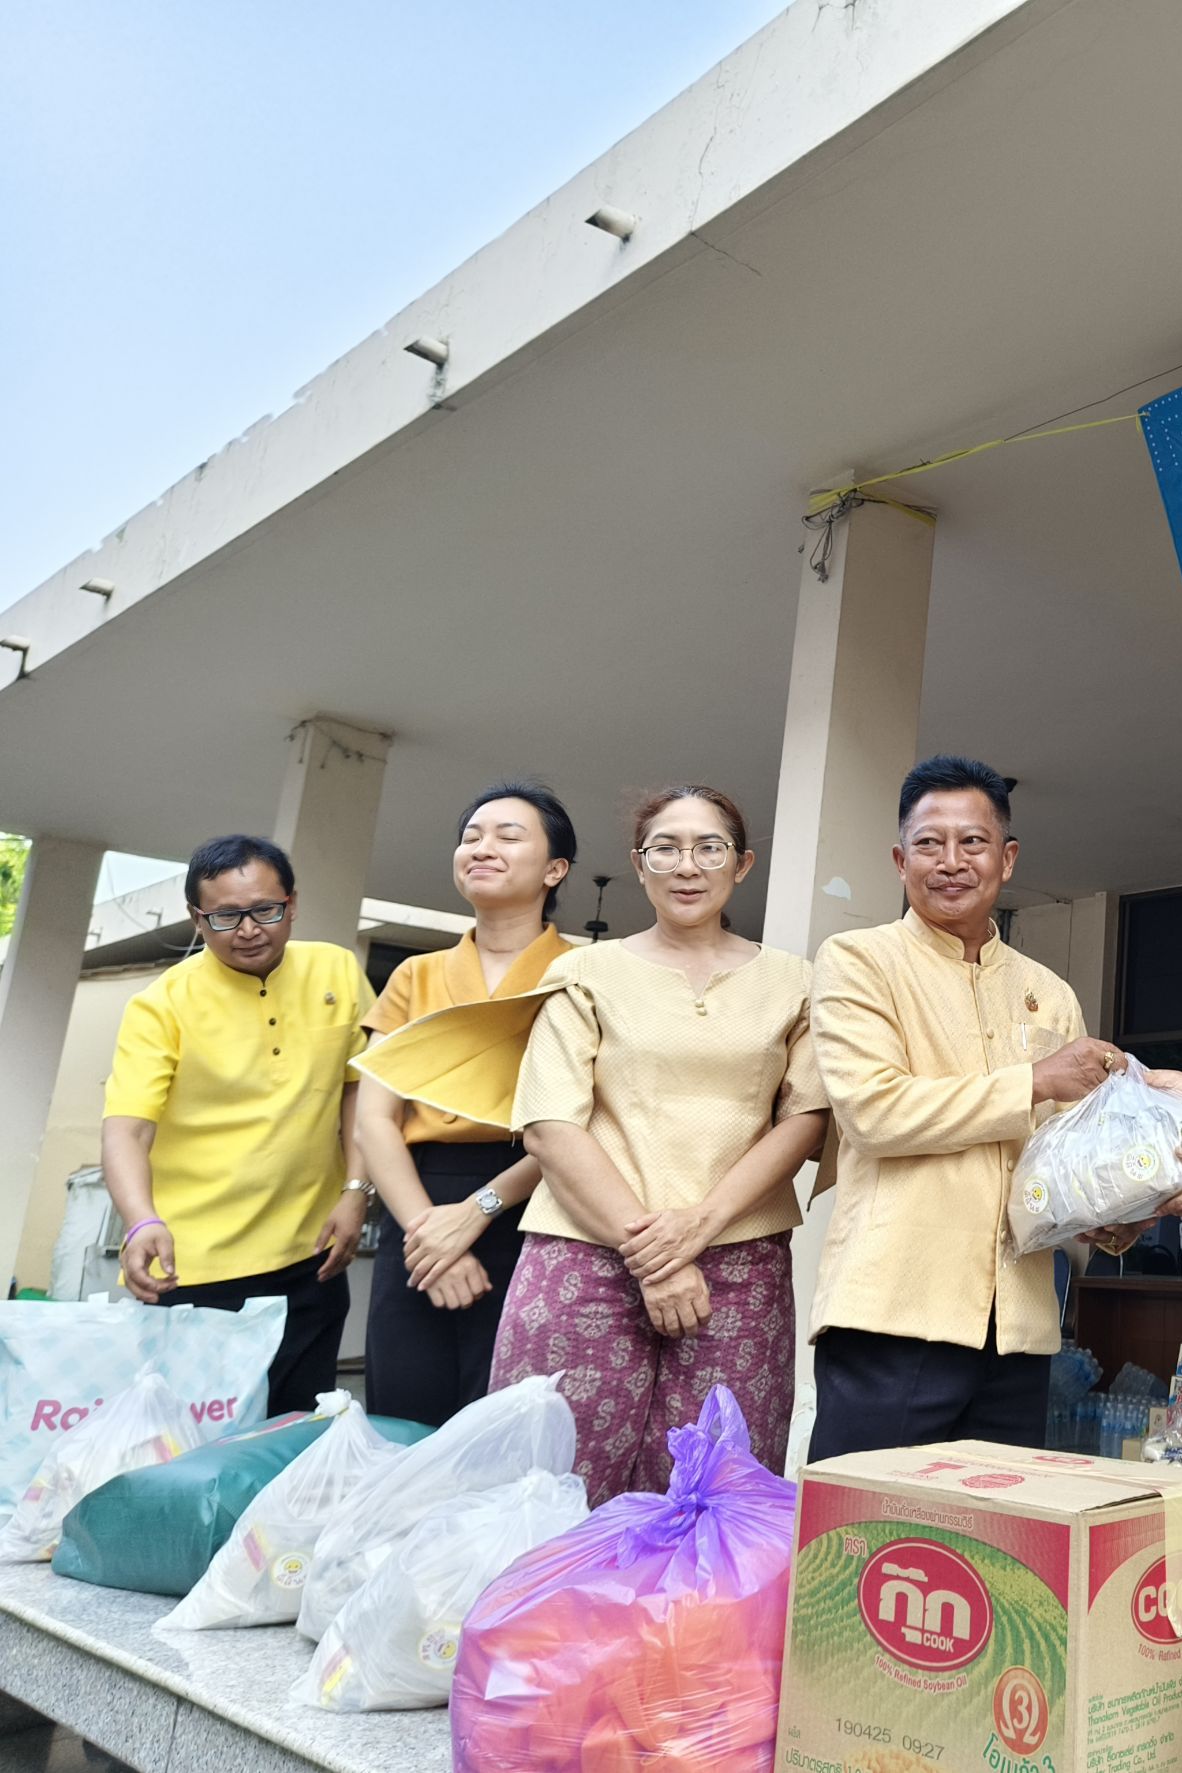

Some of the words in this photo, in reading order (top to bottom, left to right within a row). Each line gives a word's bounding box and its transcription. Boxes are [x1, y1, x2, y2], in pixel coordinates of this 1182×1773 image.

[844, 1537, 867, 1557] ตรา
[922, 1632, 955, 1653] COOK
[894, 1668, 922, 1690] Refined
[923, 1678, 955, 1694] Soybean
[956, 1674, 968, 1690] Oil
[836, 1717, 892, 1744] 190425
